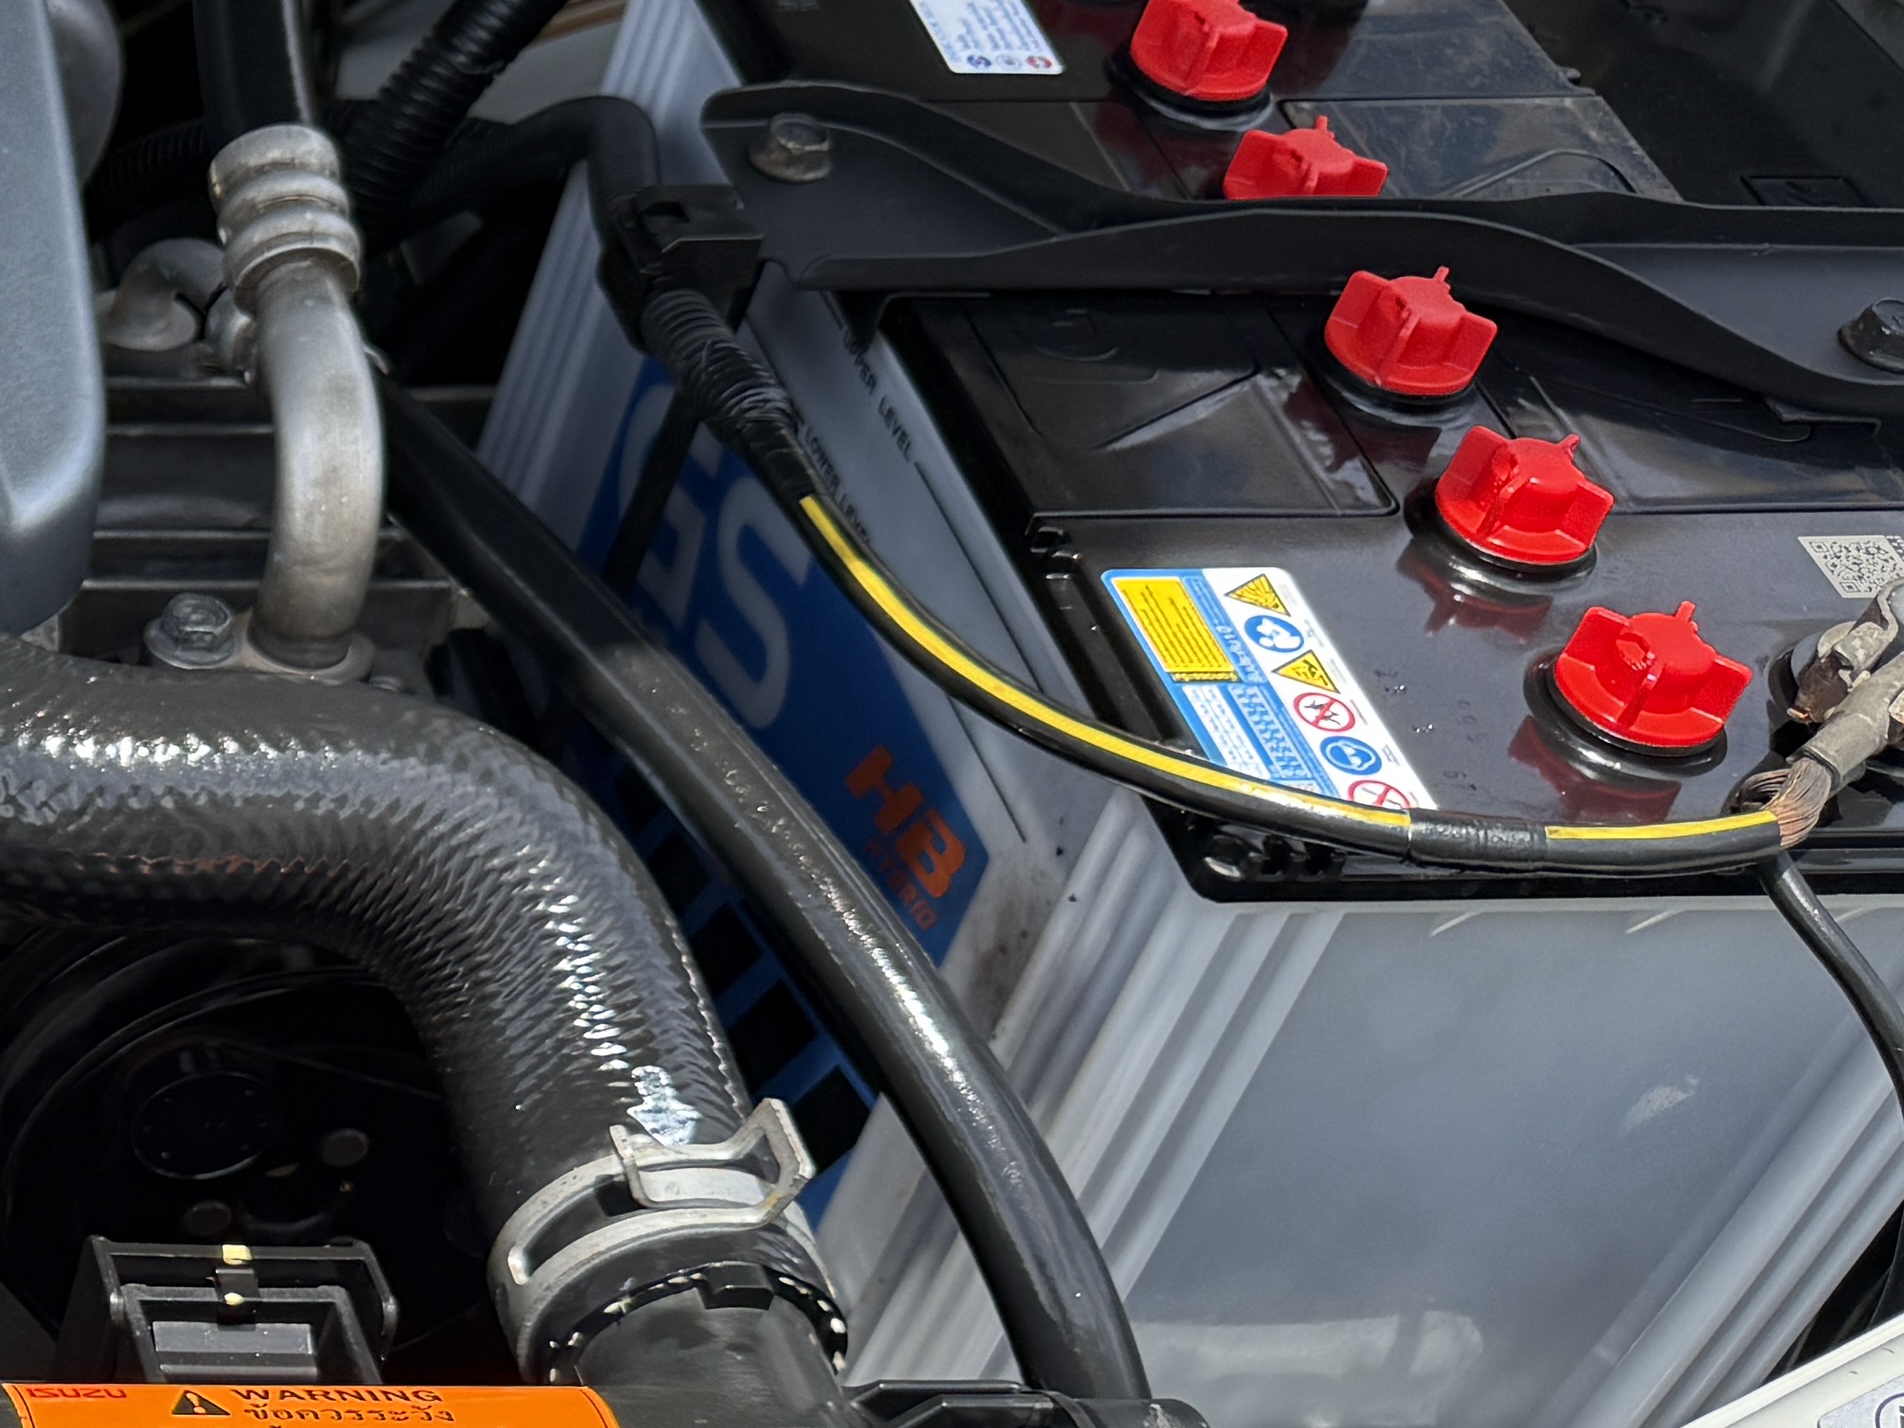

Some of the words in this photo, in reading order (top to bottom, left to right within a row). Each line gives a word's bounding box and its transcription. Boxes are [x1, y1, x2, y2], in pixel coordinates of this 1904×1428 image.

[842, 744, 968, 900] HB
[26, 1387, 128, 1400] ISUZU
[230, 1388, 444, 1403] WARNING
[243, 1402, 456, 1423] ข้อควรระวัง
